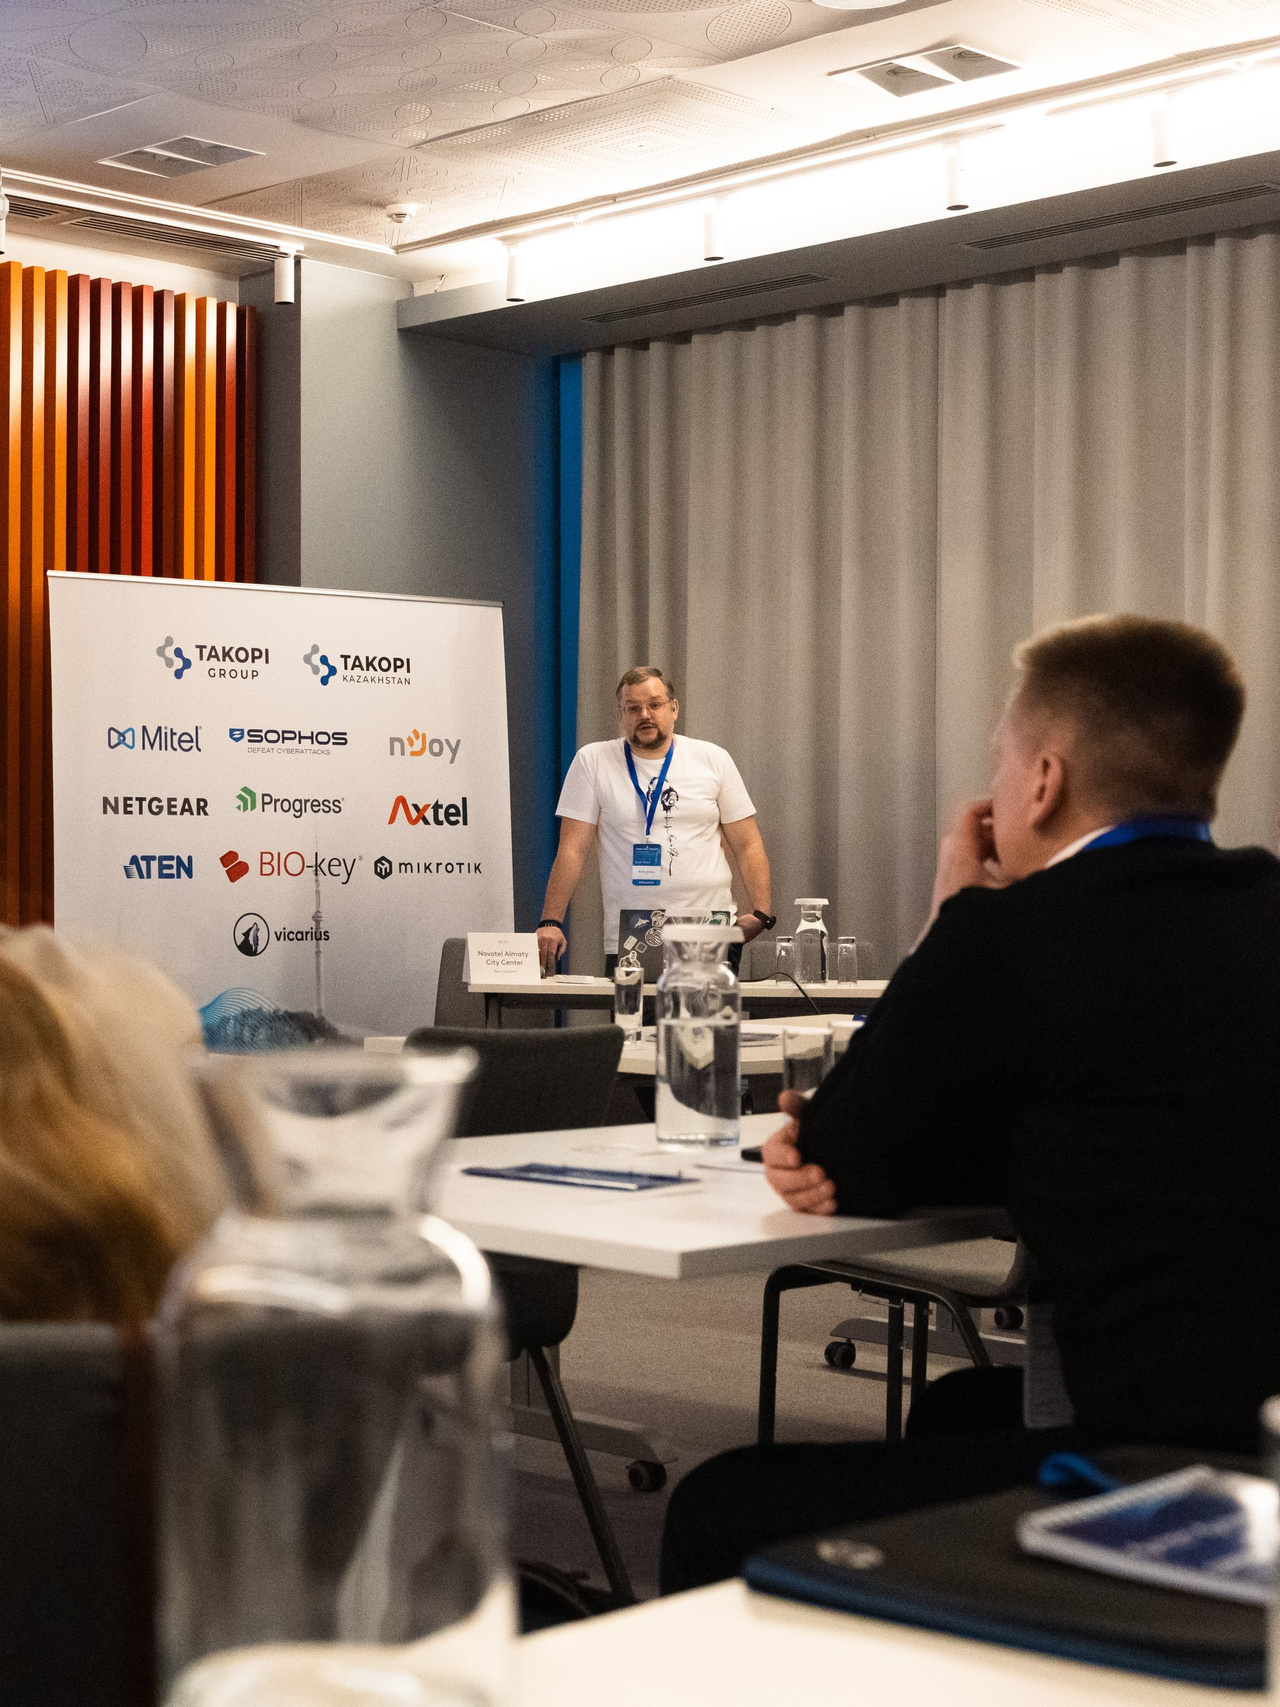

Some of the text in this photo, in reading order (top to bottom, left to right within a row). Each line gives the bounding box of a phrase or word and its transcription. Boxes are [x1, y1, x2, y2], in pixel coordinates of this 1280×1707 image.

[195, 644, 270, 665] TAKOPI
[339, 654, 411, 674] TAKOPI
[207, 667, 260, 680] GROUP
[342, 674, 411, 686] KAZAKHSTAN
[141, 724, 202, 753] Mitel
[246, 728, 349, 746] SOPHOS
[276, 748, 331, 756] CYBERATTACKS
[102, 796, 210, 817] NETGEAR
[261, 793, 342, 819] Progress
[387, 795, 468, 826] Axtel
[123, 854, 194, 880] ATEN
[259, 851, 357, 885] BIO-key
[274, 927, 330, 942] vicarius
